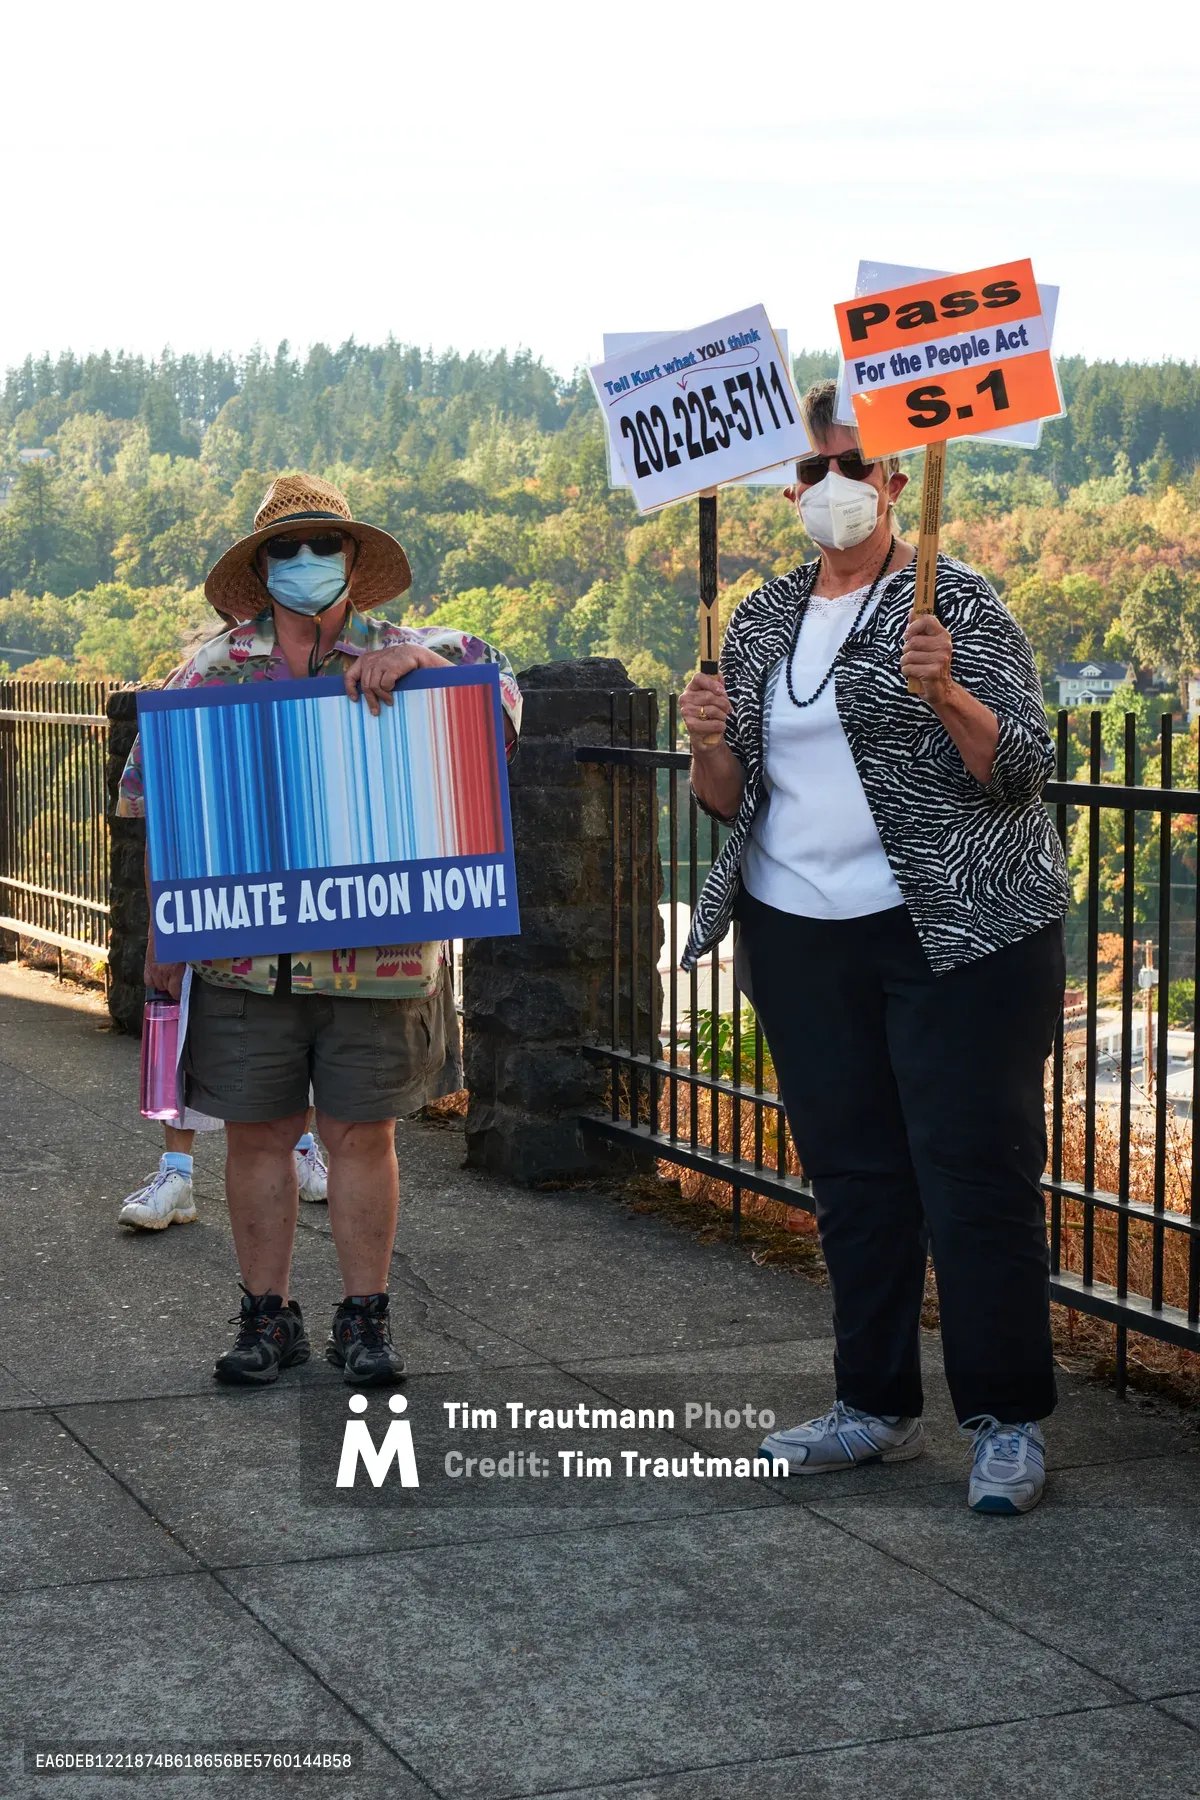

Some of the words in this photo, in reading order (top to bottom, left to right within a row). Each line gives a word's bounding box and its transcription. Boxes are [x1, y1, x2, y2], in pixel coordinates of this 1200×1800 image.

[846, 280, 1021, 342] Pass
[604, 376, 630, 395] Tell
[631, 364, 662, 386] Kurt
[662, 351, 697, 373] what
[696, 340, 726, 361] YOU
[727, 328, 761, 350] think
[855, 361, 886, 385] For
[889, 352, 922, 377] the
[925, 334, 990, 368] People
[995, 324, 1029, 352] Act
[620, 361, 795, 479] 202-225-5711
[905, 368, 1010, 428] S.1
[155, 882, 288, 935] CLIMATE
[297, 872, 412, 924] ACTION
[422, 864, 507, 913] NOW!
